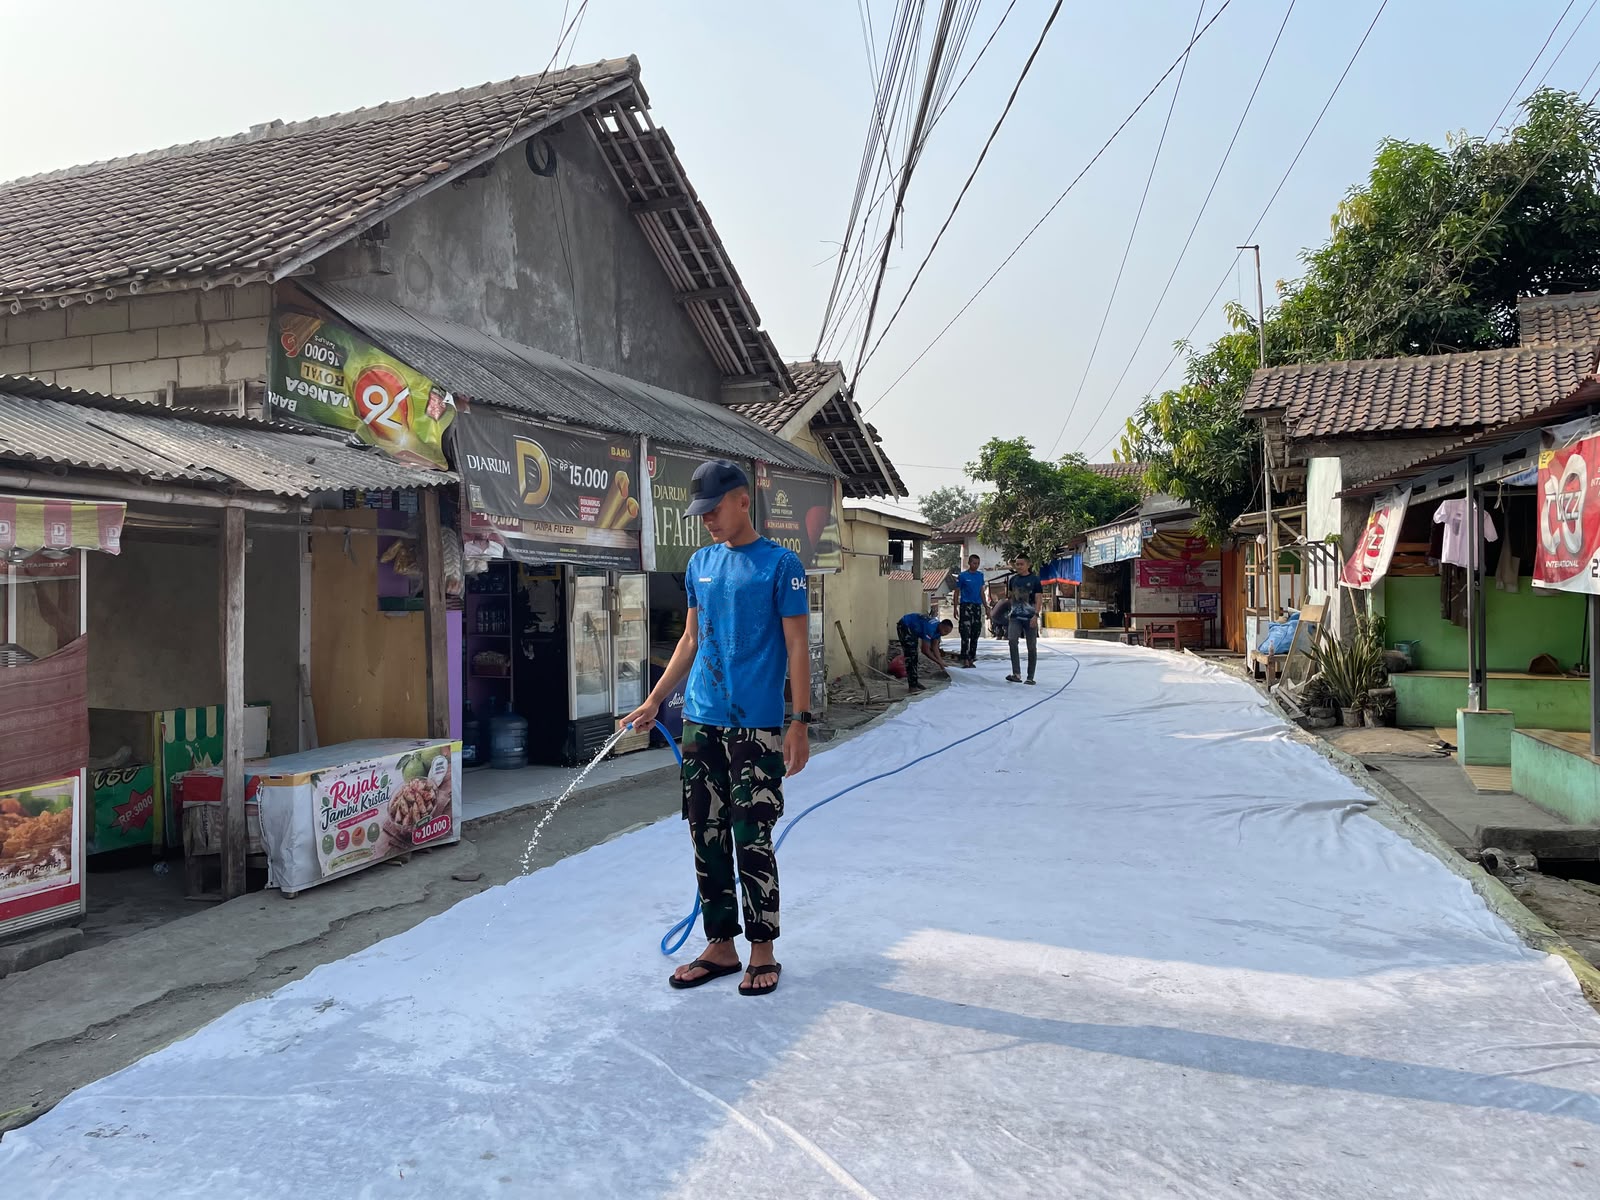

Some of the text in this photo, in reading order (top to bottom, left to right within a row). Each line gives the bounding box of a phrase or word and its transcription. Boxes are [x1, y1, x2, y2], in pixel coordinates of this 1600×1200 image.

[303, 364, 345, 388] ROYAL
[611, 447, 631, 458] BARU
[466, 454, 511, 475] DJARUM
[569, 465, 609, 490] 15.000
[654, 484, 688, 502] DJARUM
[533, 522, 574, 534] TANPA FILTER
[330, 769, 380, 810] Rujak
[321, 803, 359, 831] Jambu
[360, 785, 390, 812] Kristal
[421, 820, 447, 839] 10.000
